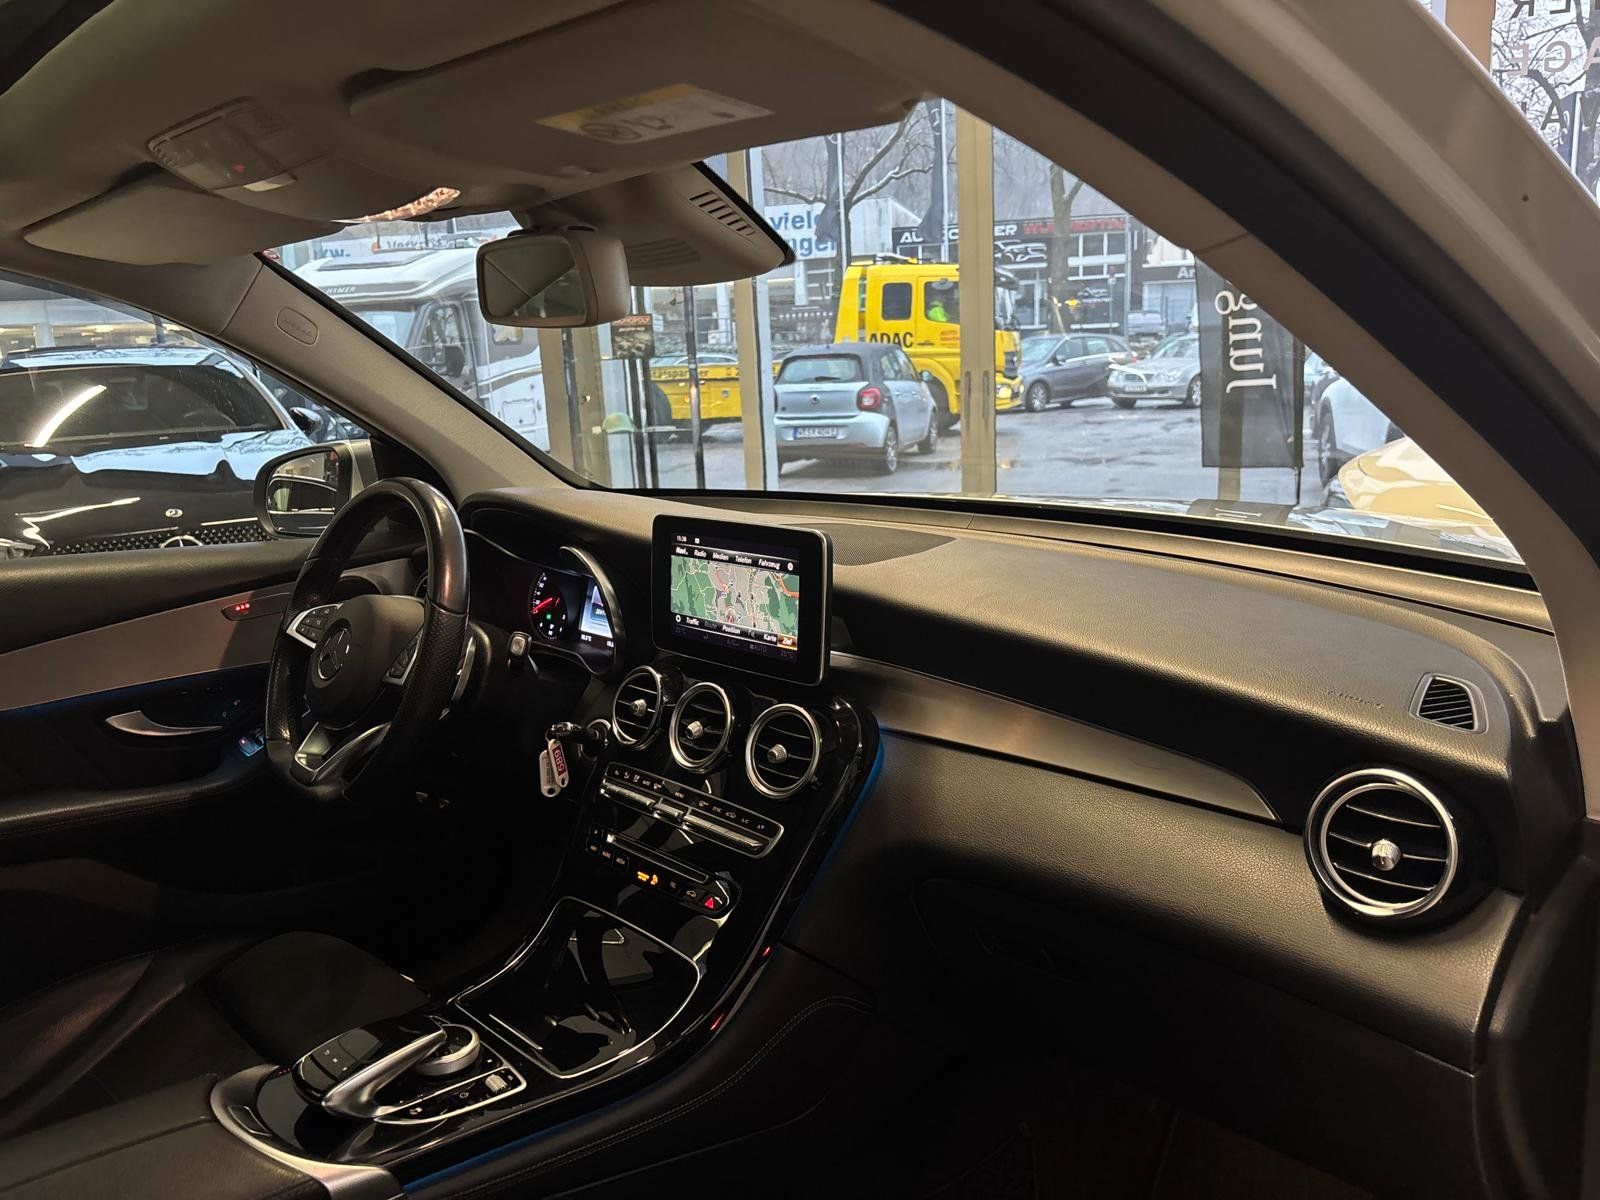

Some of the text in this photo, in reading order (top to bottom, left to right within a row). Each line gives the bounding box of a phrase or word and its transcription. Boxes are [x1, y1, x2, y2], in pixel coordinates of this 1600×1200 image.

[869, 331, 914, 348] ADAC
[693, 549, 707, 559] Radio
[712, 552, 729, 561] Medien
[735, 555, 753, 565] Telefon
[758, 558, 781, 570] Fahrzeug
[722, 624, 741, 635] Position
[763, 633, 777, 643] Karte
